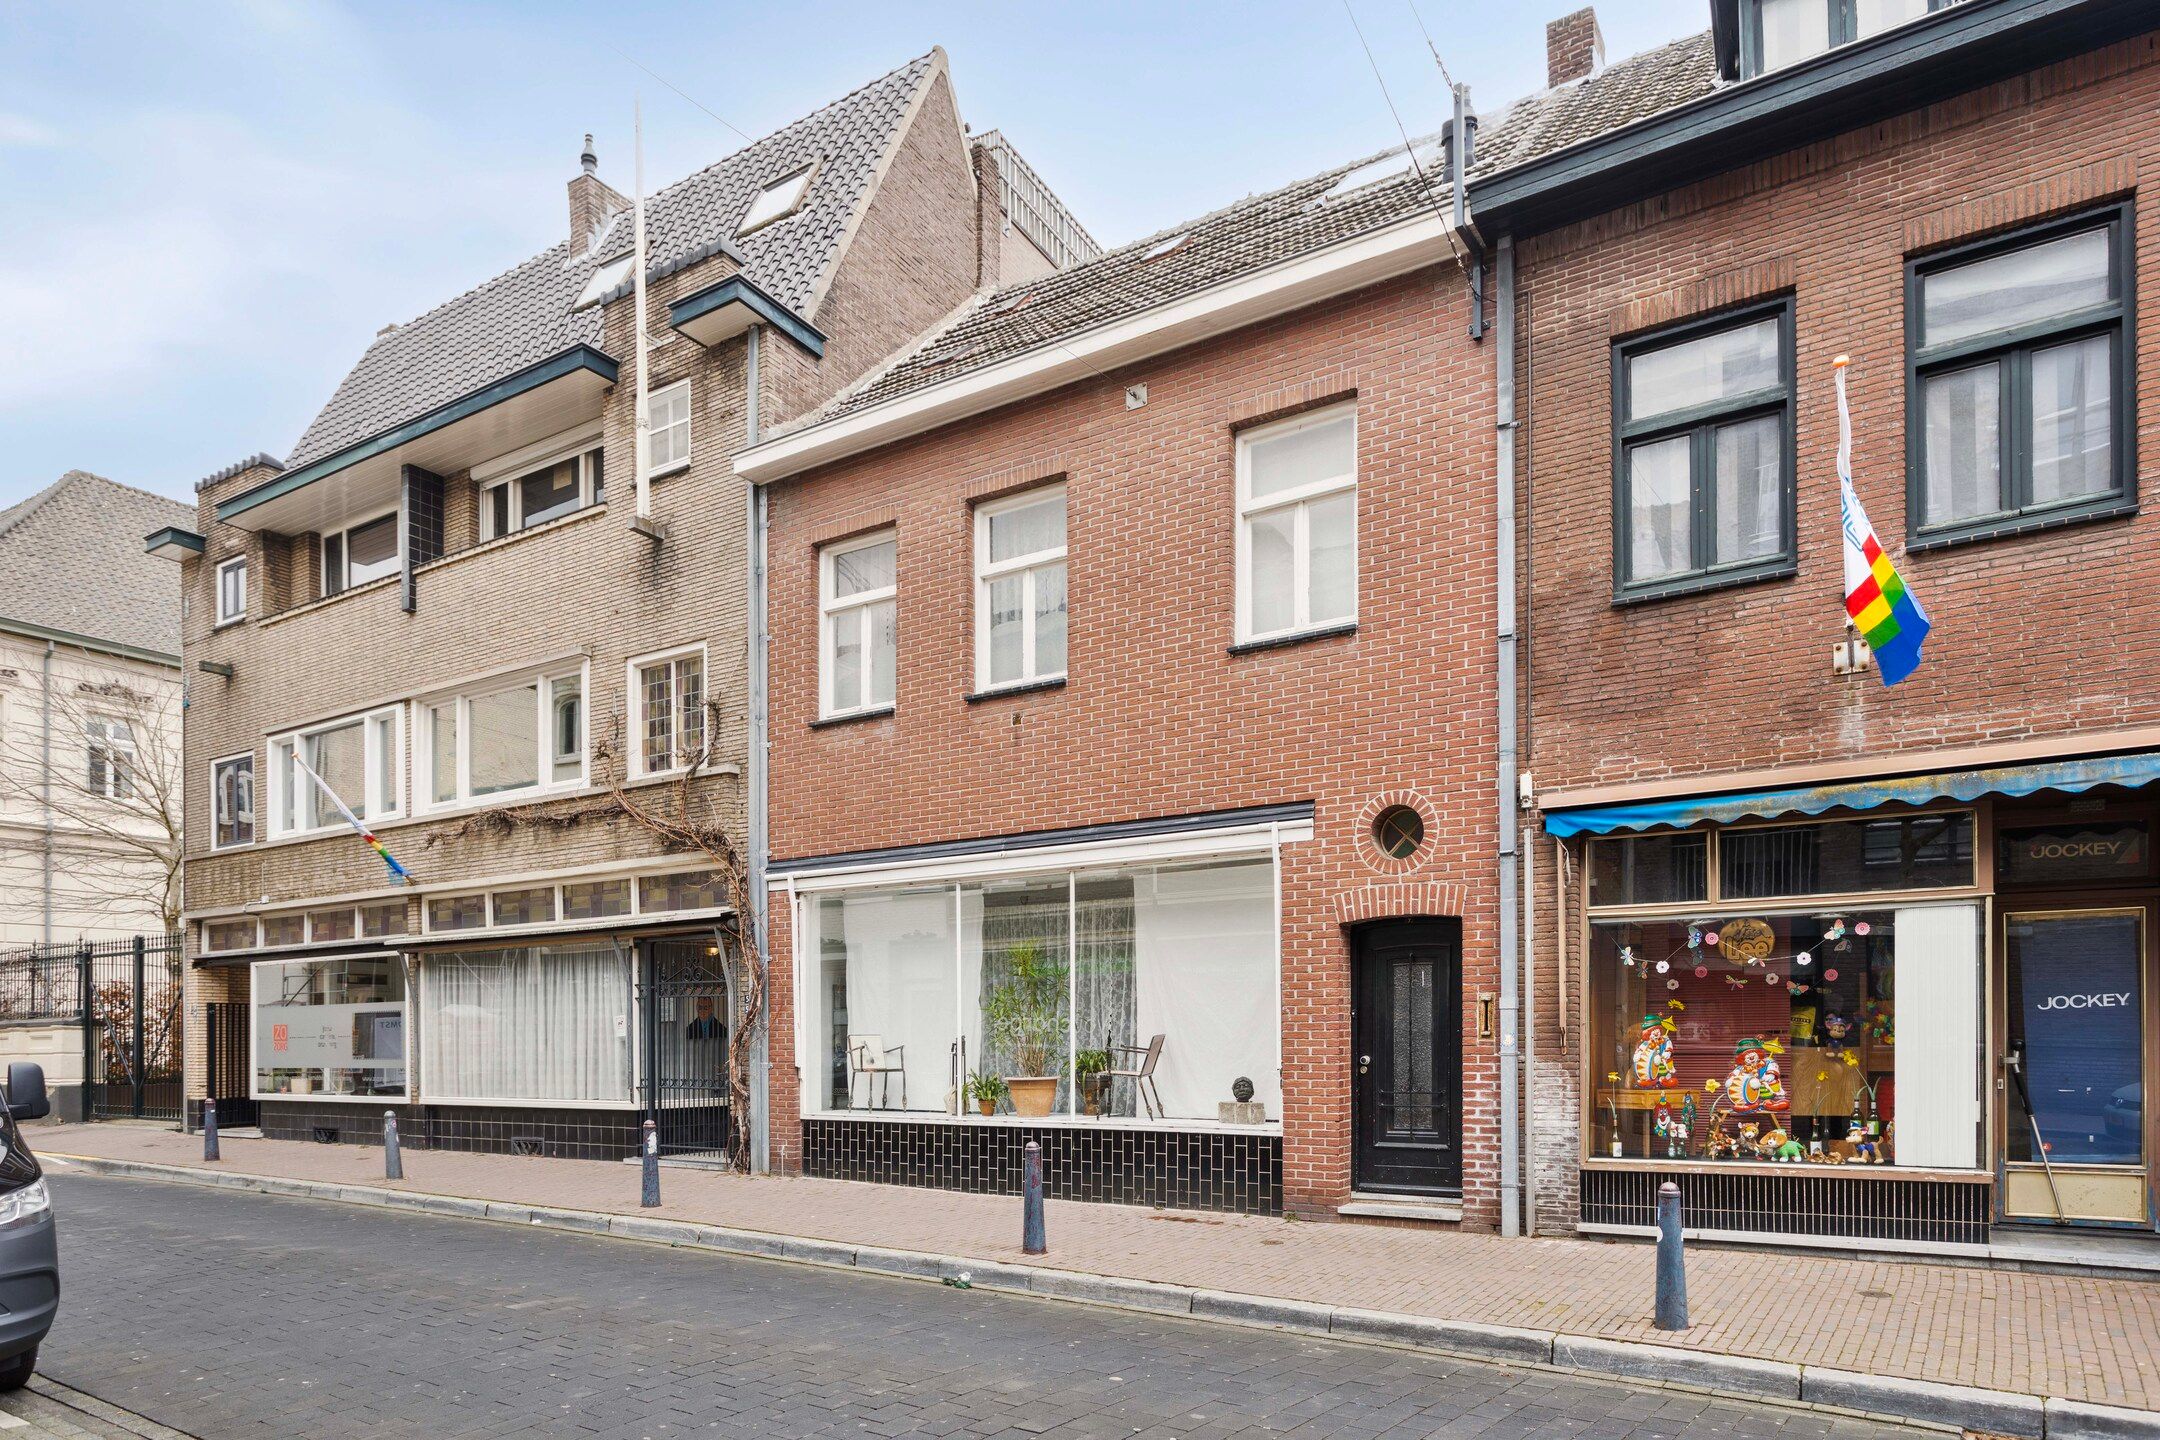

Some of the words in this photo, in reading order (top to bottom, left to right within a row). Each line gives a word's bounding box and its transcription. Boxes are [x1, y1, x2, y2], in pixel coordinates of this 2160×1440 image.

[2030, 841, 2121, 859] JOCKEY
[1726, 936, 1769, 960] Lee
[2037, 992, 2131, 1011] JOCKEY
